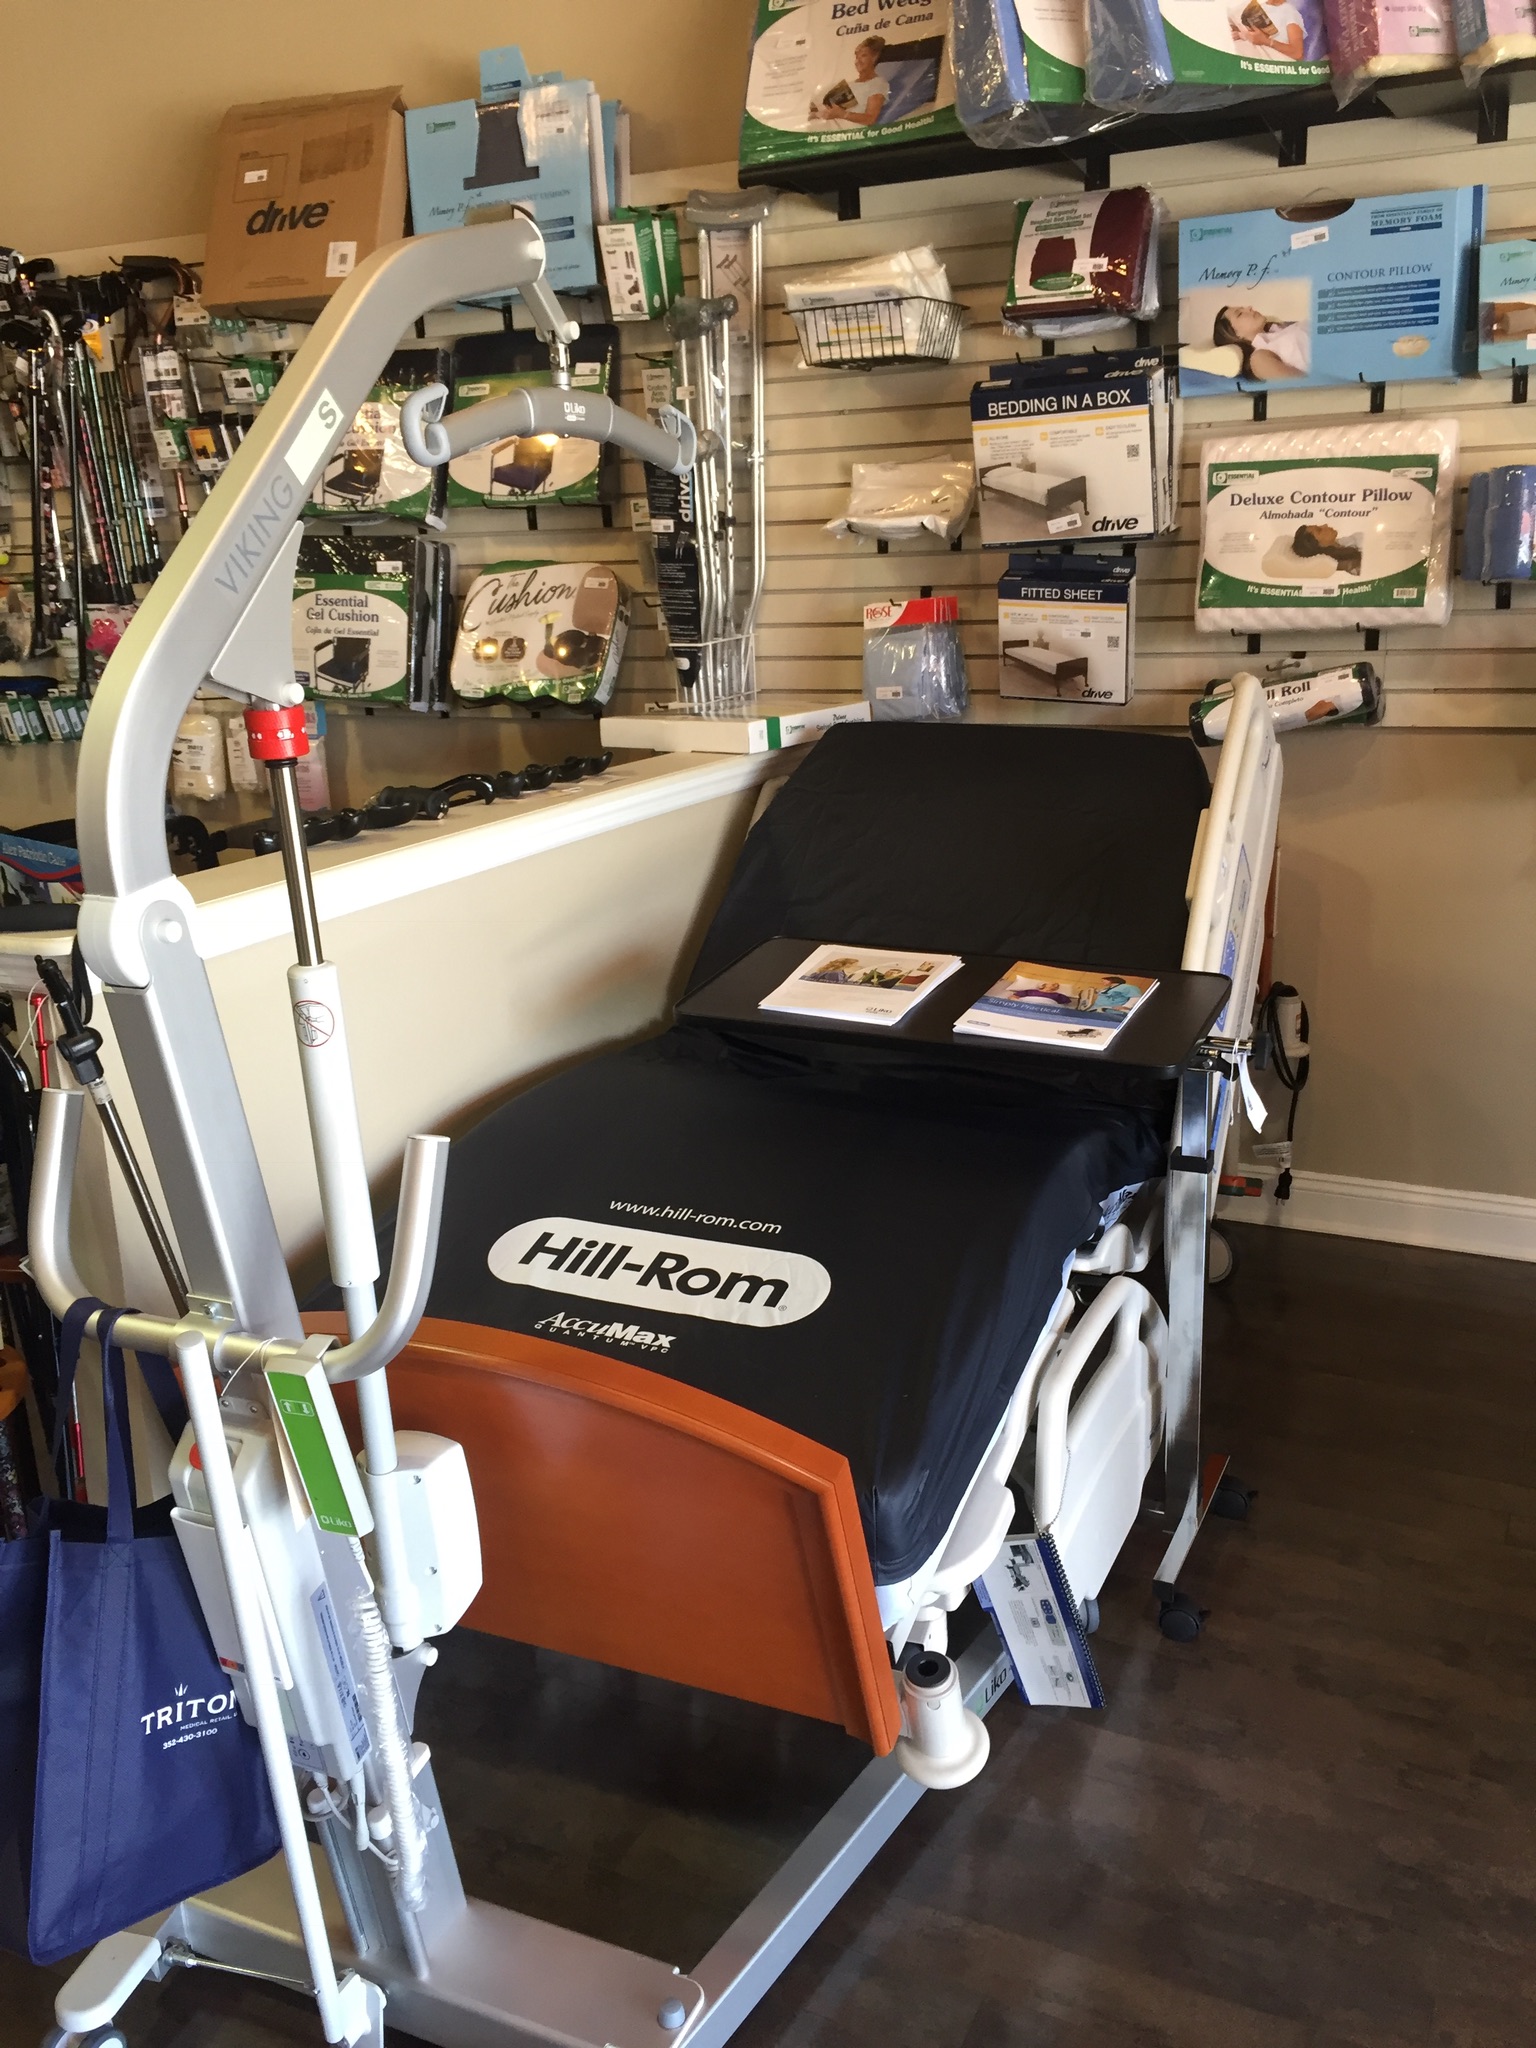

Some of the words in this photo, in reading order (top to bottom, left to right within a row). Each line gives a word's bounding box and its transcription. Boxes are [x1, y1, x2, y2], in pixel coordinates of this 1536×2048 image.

[832, 0, 869, 20] Bed
[835, 23, 870, 37] Cuña
[874, 18, 891, 30] de
[895, 12, 934, 26] Cama
[1240, 59, 1253, 71] It's
[1254, 62, 1297, 75] ESSENTIAL
[1298, 65, 1310, 75] for
[1311, 65, 1331, 75] Good
[807, 134, 819, 143] It's
[820, 130, 865, 143] ESSENTIAL
[867, 129, 879, 137] for
[881, 124, 903, 135] Good
[904, 115, 935, 130] Health!
[246, 200, 330, 236] drive
[1371, 216, 1413, 227] MEMORY
[1415, 213, 1443, 222] FOAM
[1199, 267, 1243, 288] Memory
[1327, 268, 1386, 282] CONTOUR
[1389, 263, 1434, 277] PILLOW
[1134, 356, 1160, 368] drive
[988, 395, 1058, 417] BEDDING
[1062, 393, 1078, 410] IN
[1081, 392, 1095, 408] A
[1097, 388, 1131, 406] BOX
[318, 400, 337, 429] S
[678, 472, 692, 523] drive
[1230, 492, 1284, 507] Deluxe
[1290, 489, 1356, 505] Contour
[1362, 487, 1413, 502] Pillow
[1259, 508, 1314, 520] Almohada
[1091, 515, 1139, 533] drive
[214, 474, 294, 594] VIKING
[1112, 566, 1131, 574] drive
[1021, 587, 1061, 599] FITTED
[1063, 588, 1103, 601] SHEET
[1247, 585, 1259, 594] It's
[1342, 584, 1372, 596] Health!
[315, 593, 368, 608] Essential
[461, 569, 577, 633] Cushion
[306, 607, 324, 620] Gel
[328, 608, 379, 622] Cushion
[333, 627, 346, 635] Gel
[1081, 687, 1113, 699] drive
[1281, 681, 1311, 697] Roll
[987, 997, 1019, 1008] Simply
[610, 1200, 782, 1235] www.hill-rom.com
[518, 1231, 790, 1309] Hill-Rom
[538, 1311, 677, 1348] AccuMax
[640, 1343, 669, 1354] VPC
[328, 1517, 352, 1528] Liko
[984, 1666, 1007, 1699] Liko
[180, 1720, 208, 1731] MEDICAL
[162, 1727, 218, 1750] 352-430-3100
